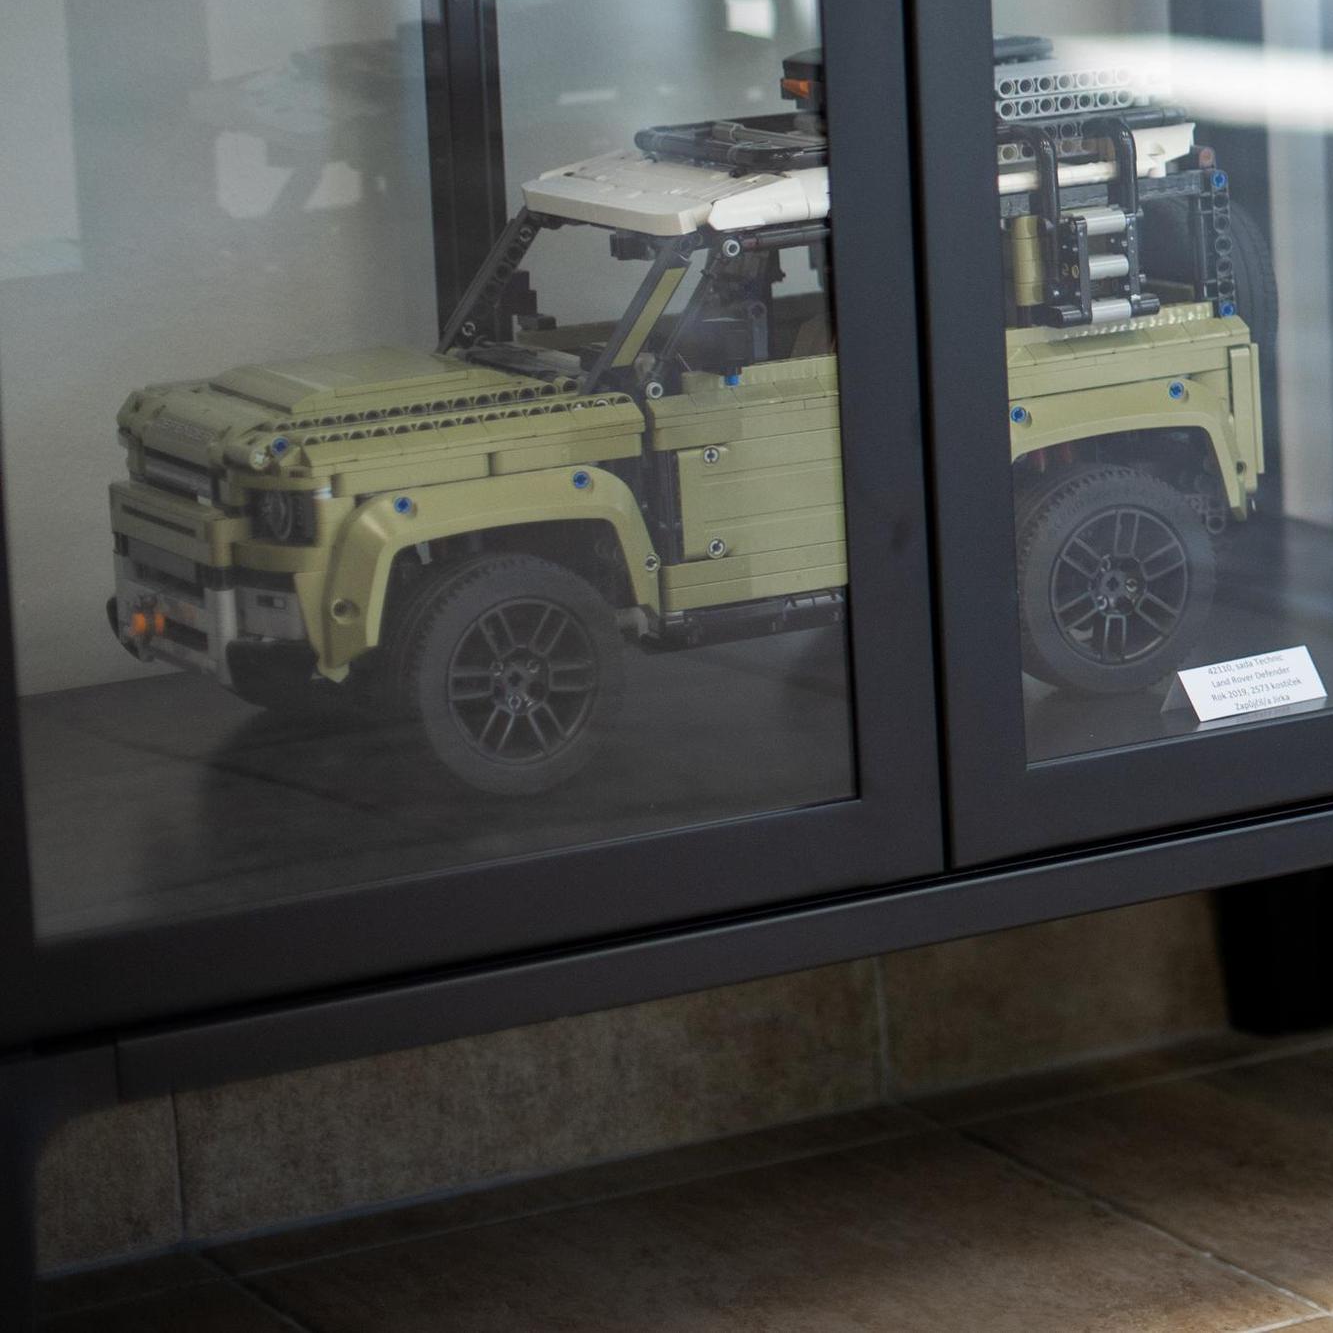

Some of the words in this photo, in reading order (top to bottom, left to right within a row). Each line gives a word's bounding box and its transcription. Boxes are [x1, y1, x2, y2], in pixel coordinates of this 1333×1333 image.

[1254, 654, 1284, 667] Technic
[1211, 677, 1231, 689] Land
[1231, 673, 1254, 685] Rover
[1254, 666, 1290, 681] Defender
[1211, 691, 1226, 702] Rok
[1250, 683, 1270, 695] 2573
